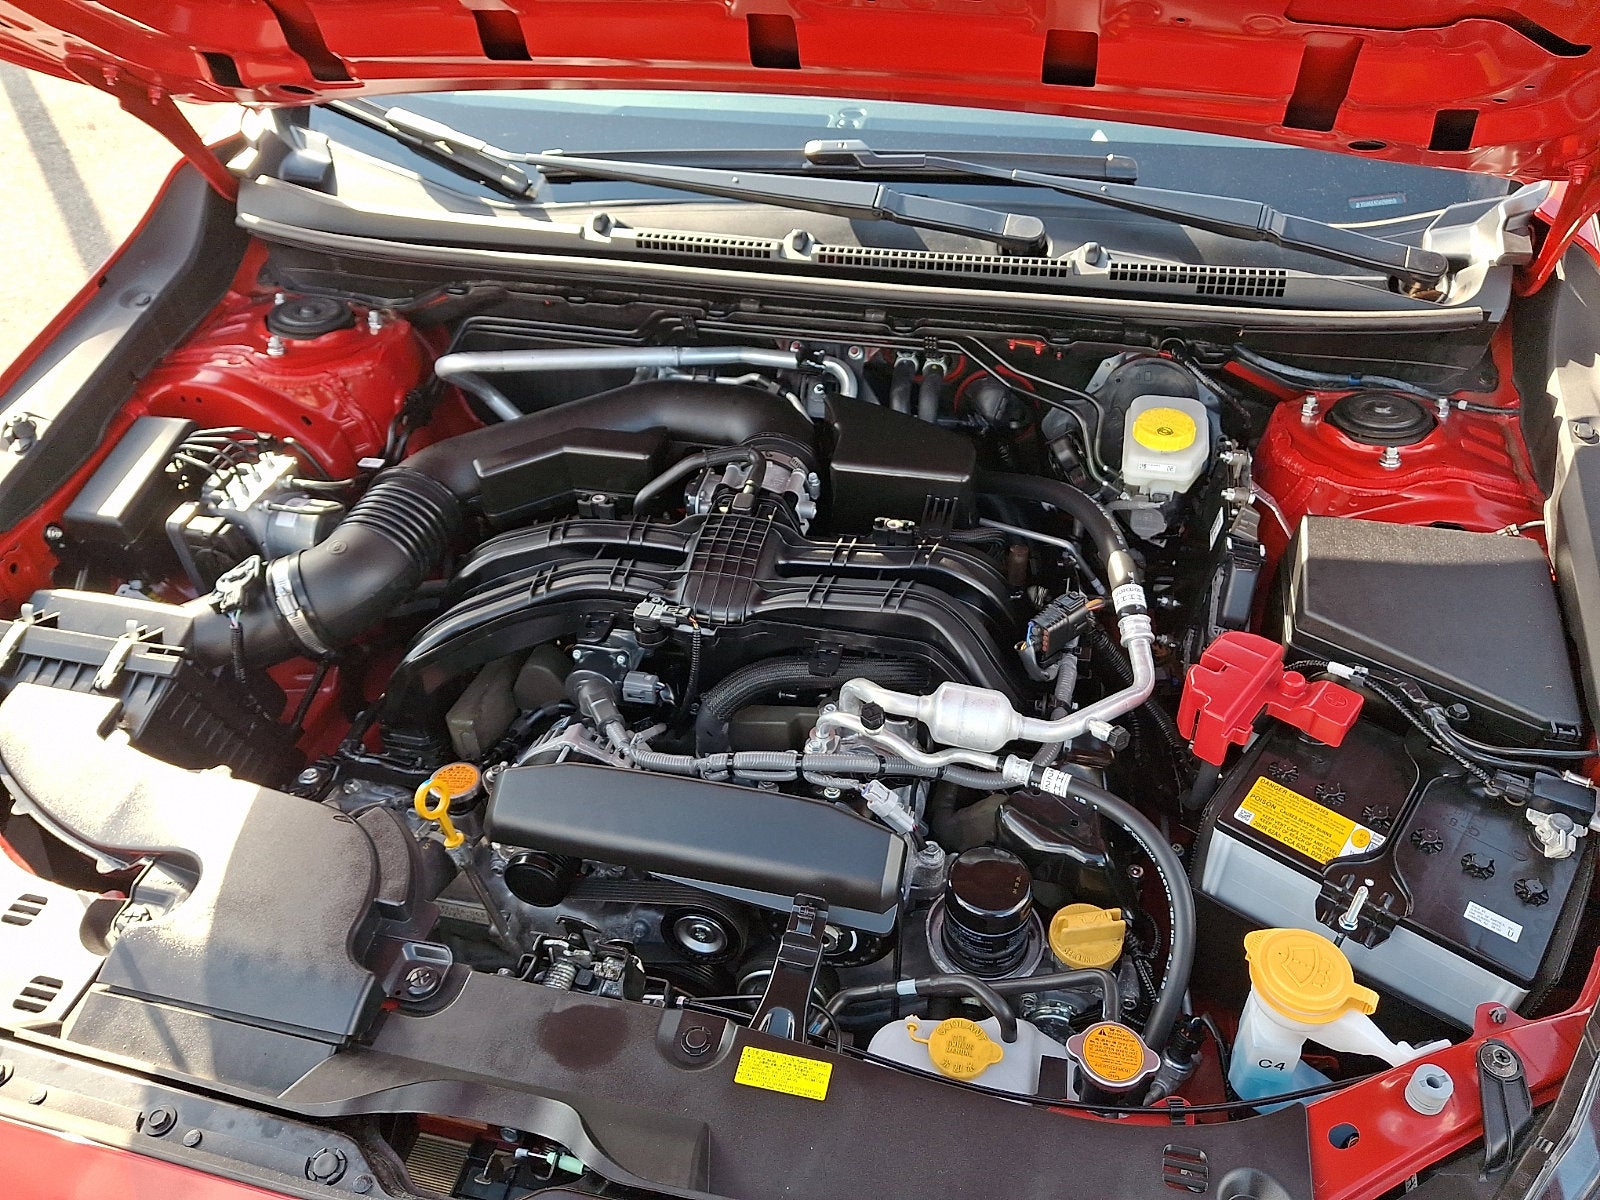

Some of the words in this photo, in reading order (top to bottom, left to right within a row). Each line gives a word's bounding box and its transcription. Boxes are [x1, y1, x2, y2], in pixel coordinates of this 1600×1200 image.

[1260, 779, 1287, 794] DANGER
[1250, 793, 1276, 809] POISON
[1130, 830, 1156, 863] YOKOHAMA
[1282, 836, 1295, 845] CCA
[936, 1020, 987, 1041] COOLANT
[1258, 1059, 1286, 1072] C4
